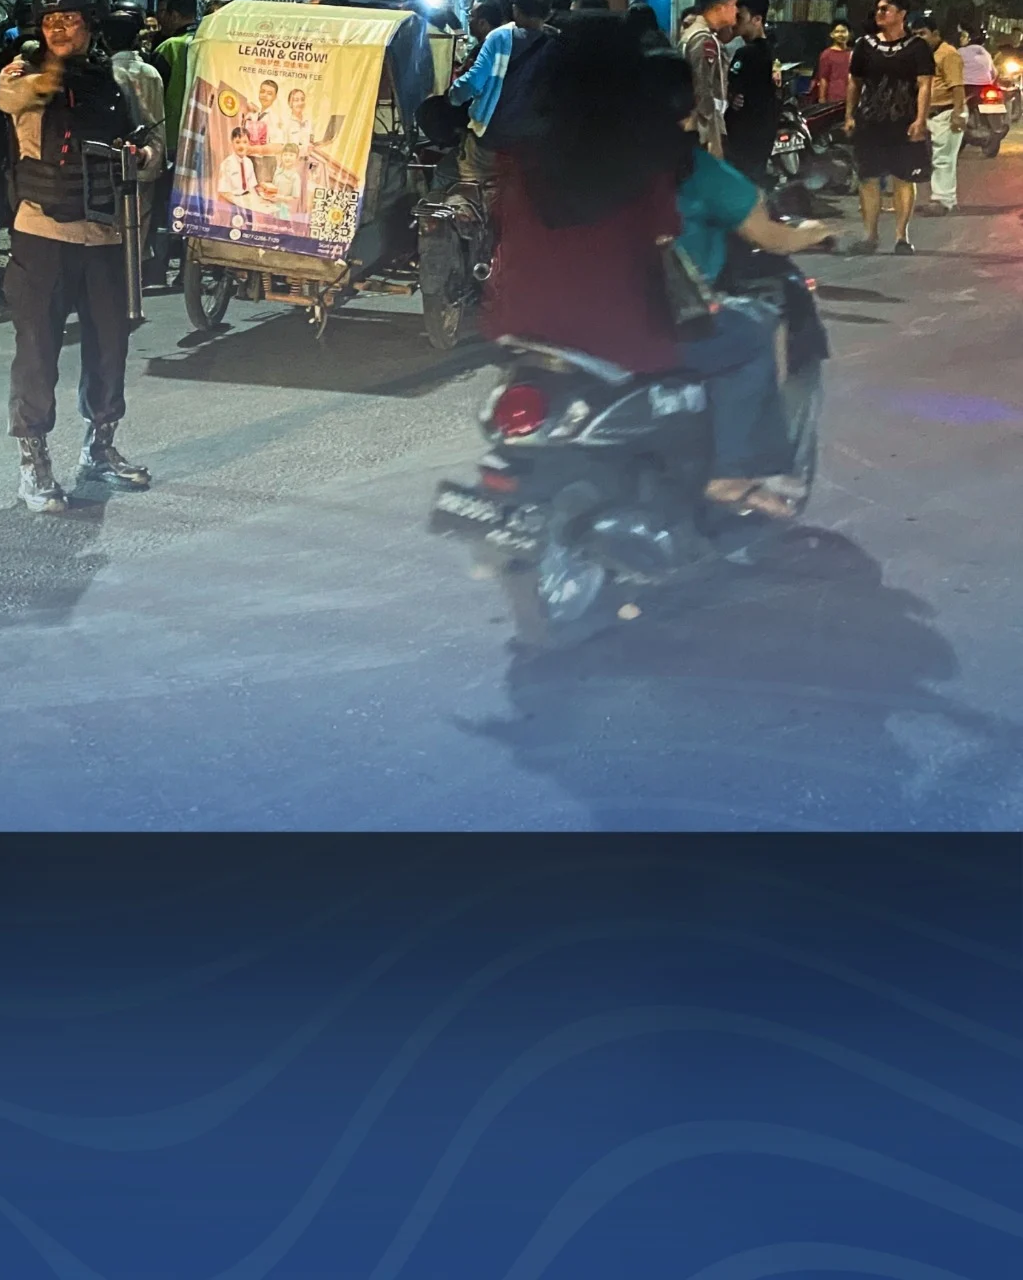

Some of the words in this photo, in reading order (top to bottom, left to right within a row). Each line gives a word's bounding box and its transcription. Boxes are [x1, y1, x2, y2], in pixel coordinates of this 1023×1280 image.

[256, 38, 313, 52] DISCOVER
[238, 45, 275, 59] LEARN
[277, 50, 286, 60] &
[288, 51, 328, 64] GROW!
[239, 66, 256, 74] FREE
[258, 68, 308, 81] REGISTRATION
[309, 73, 323, 81] FEE
